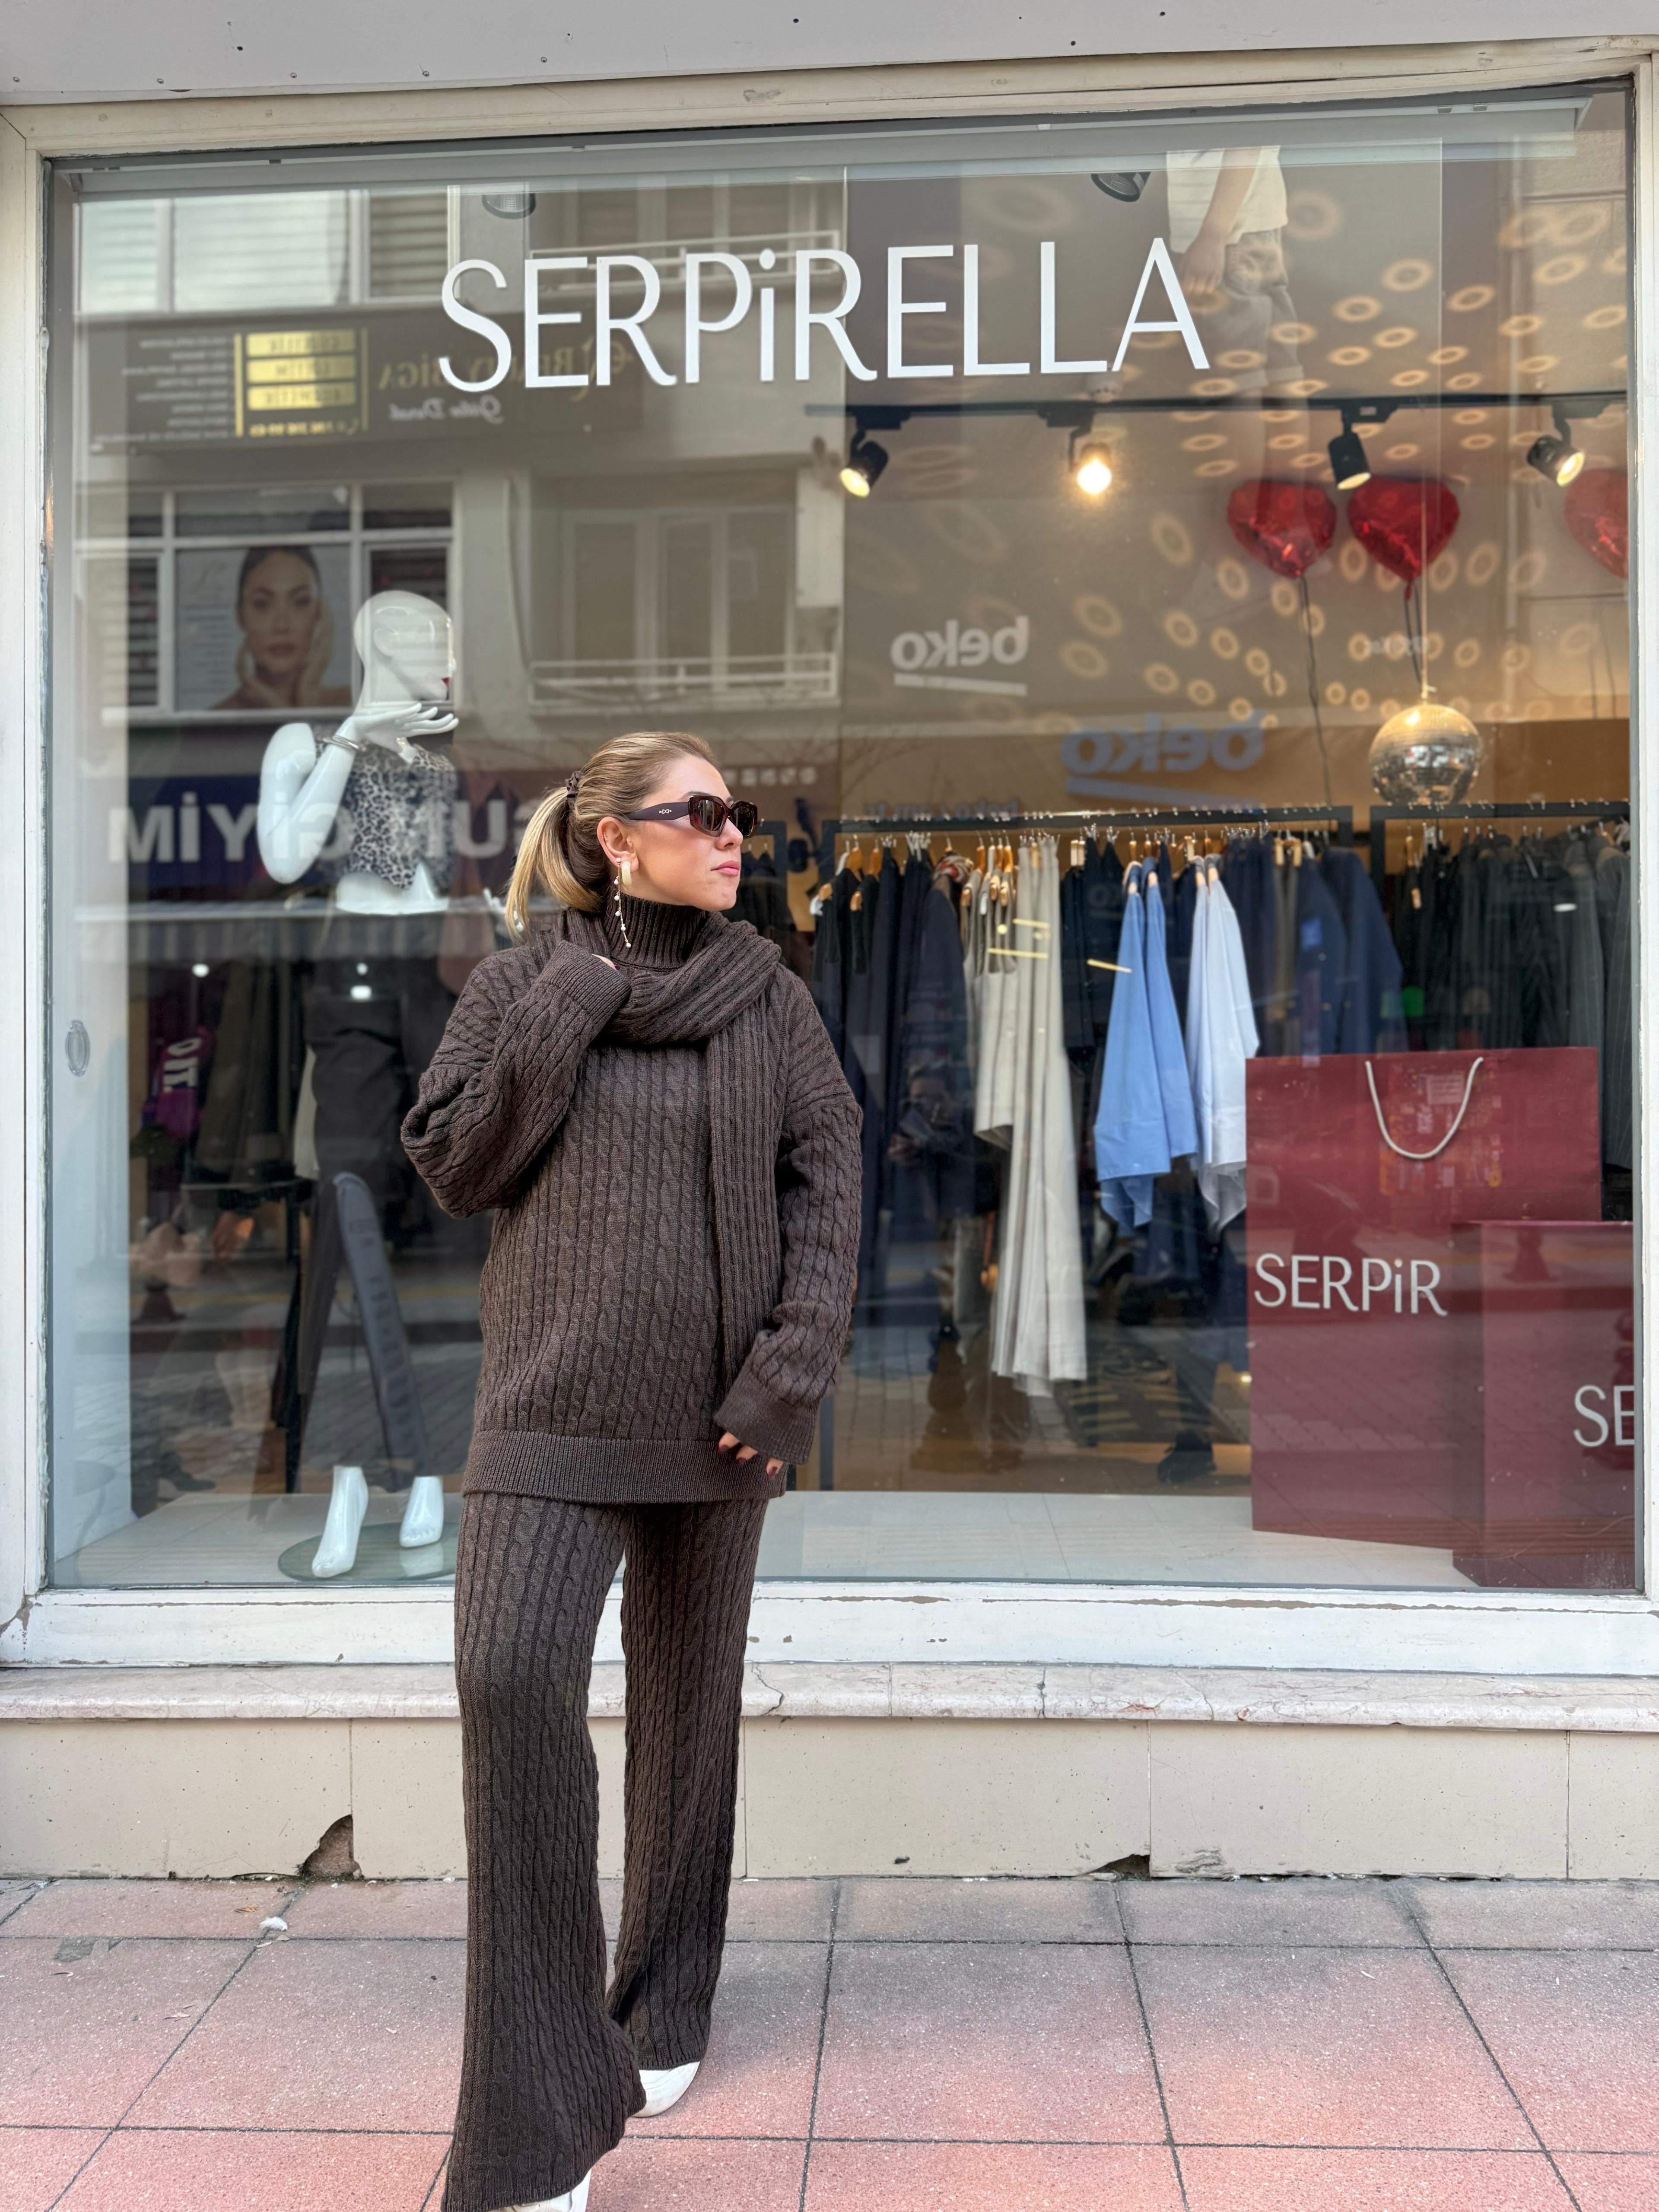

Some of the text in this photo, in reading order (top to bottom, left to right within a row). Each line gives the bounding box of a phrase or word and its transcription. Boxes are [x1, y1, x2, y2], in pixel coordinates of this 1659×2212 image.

[438, 238, 1210, 393] SERPiRELLA
[1254, 1253, 1447, 1316] SERPiR
[1573, 1384, 1635, 1447] SE
